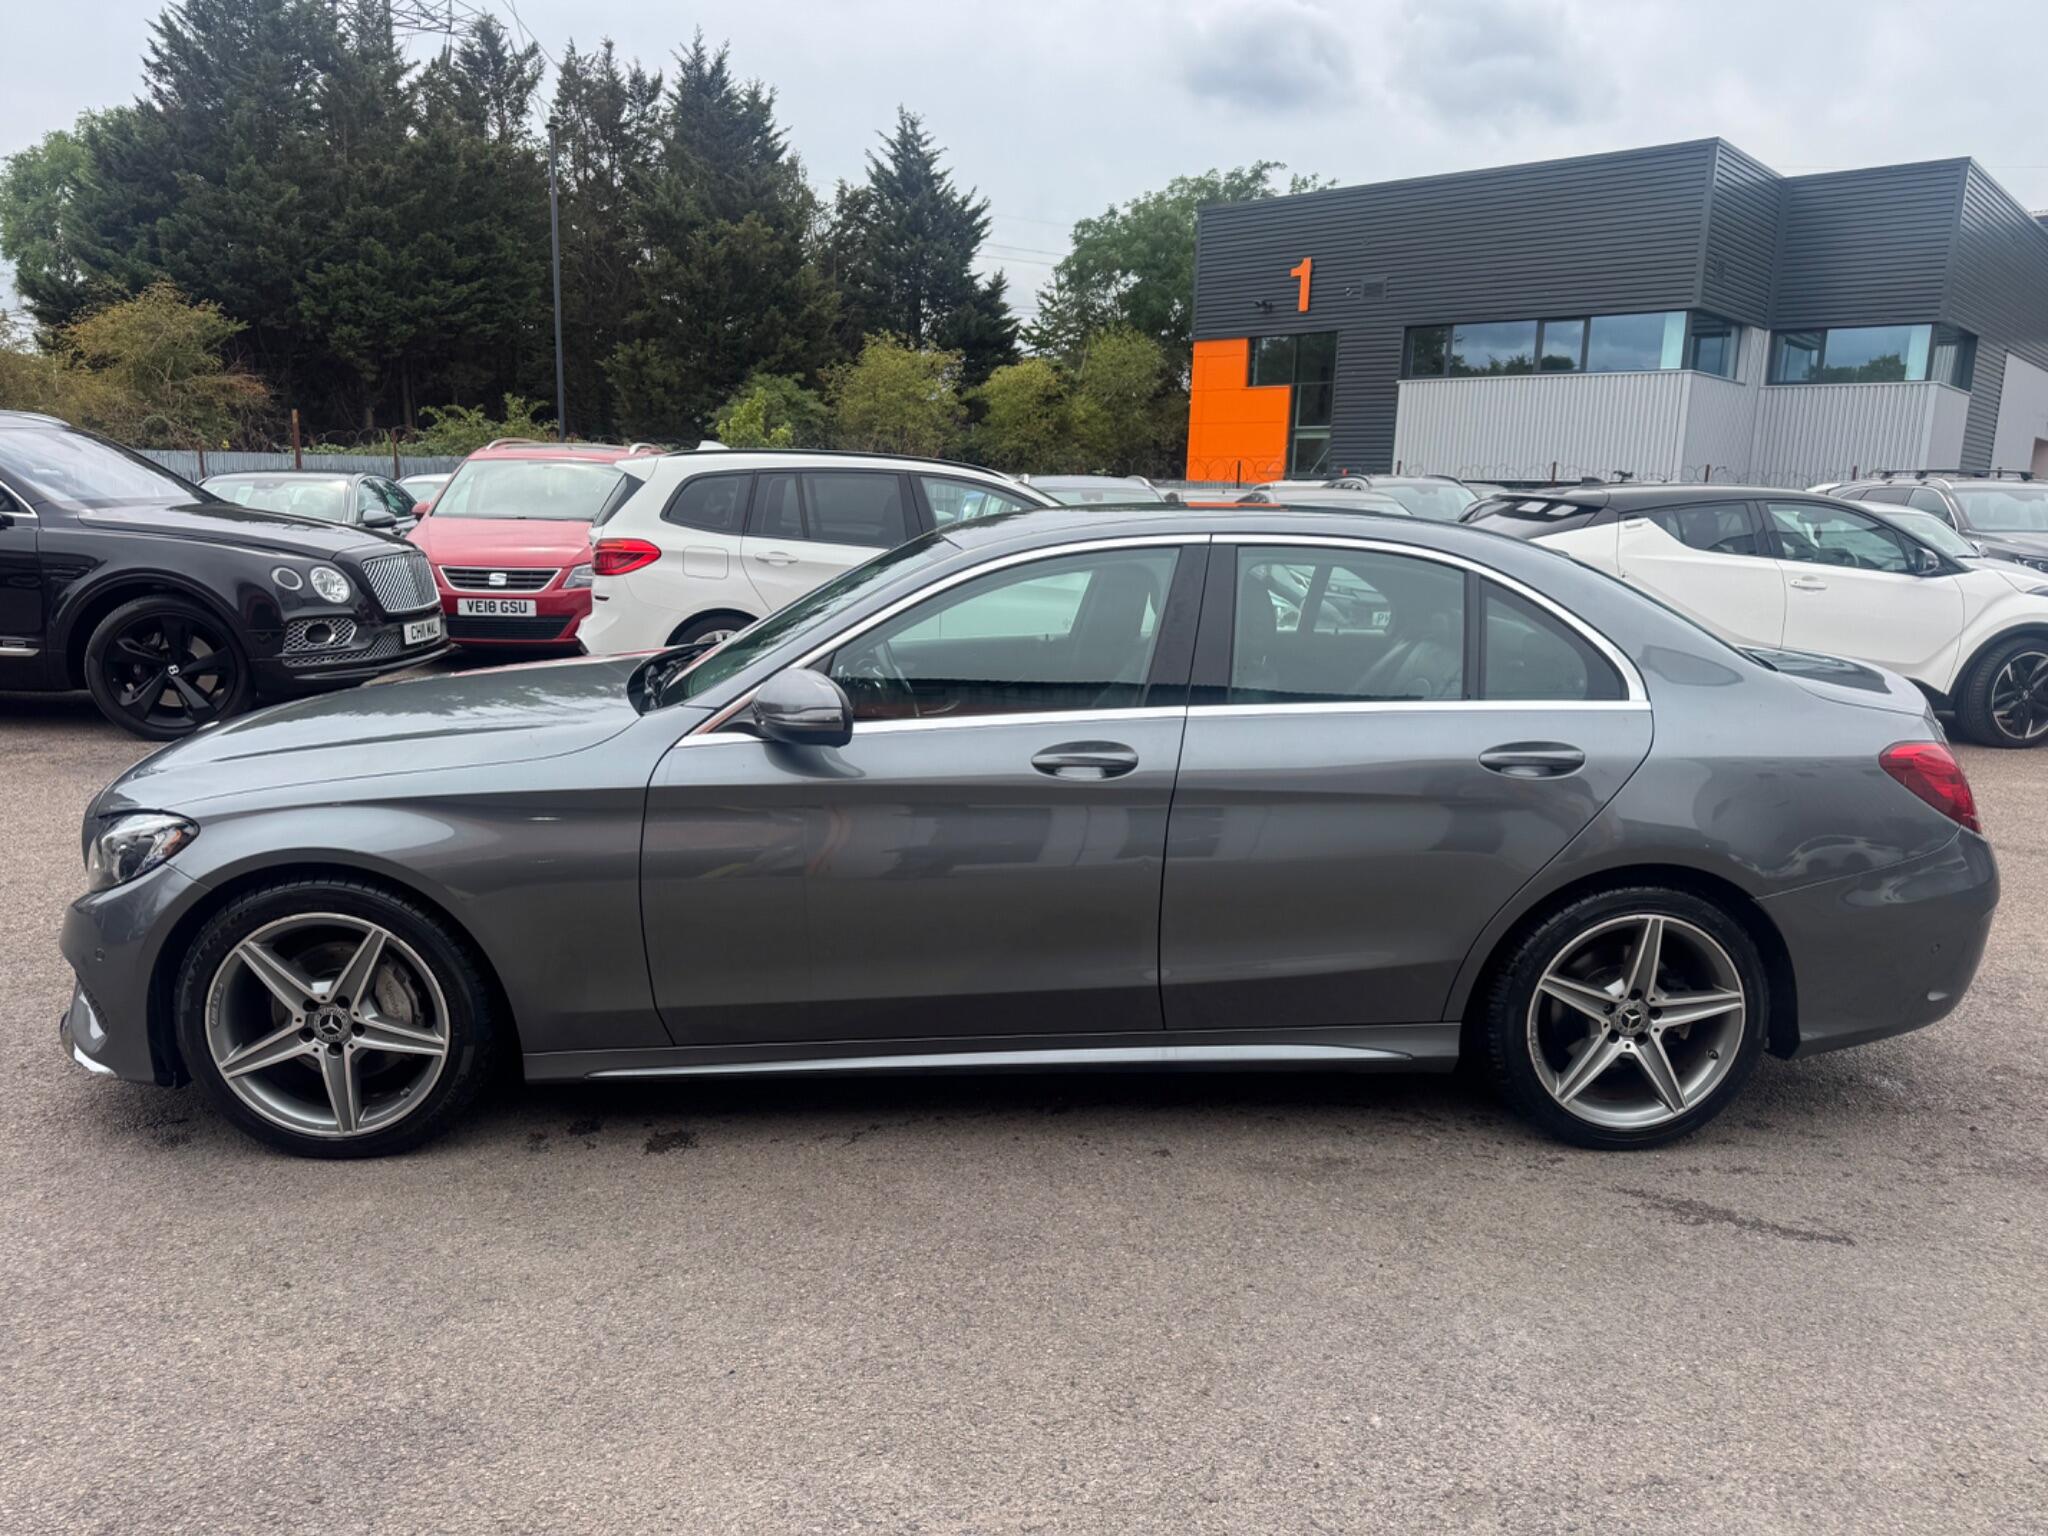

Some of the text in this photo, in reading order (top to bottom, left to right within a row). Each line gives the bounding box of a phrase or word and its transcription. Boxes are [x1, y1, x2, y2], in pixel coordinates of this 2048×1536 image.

[1290, 256, 1312, 312] 1
[466, 600, 527, 614] VE18 GSU
